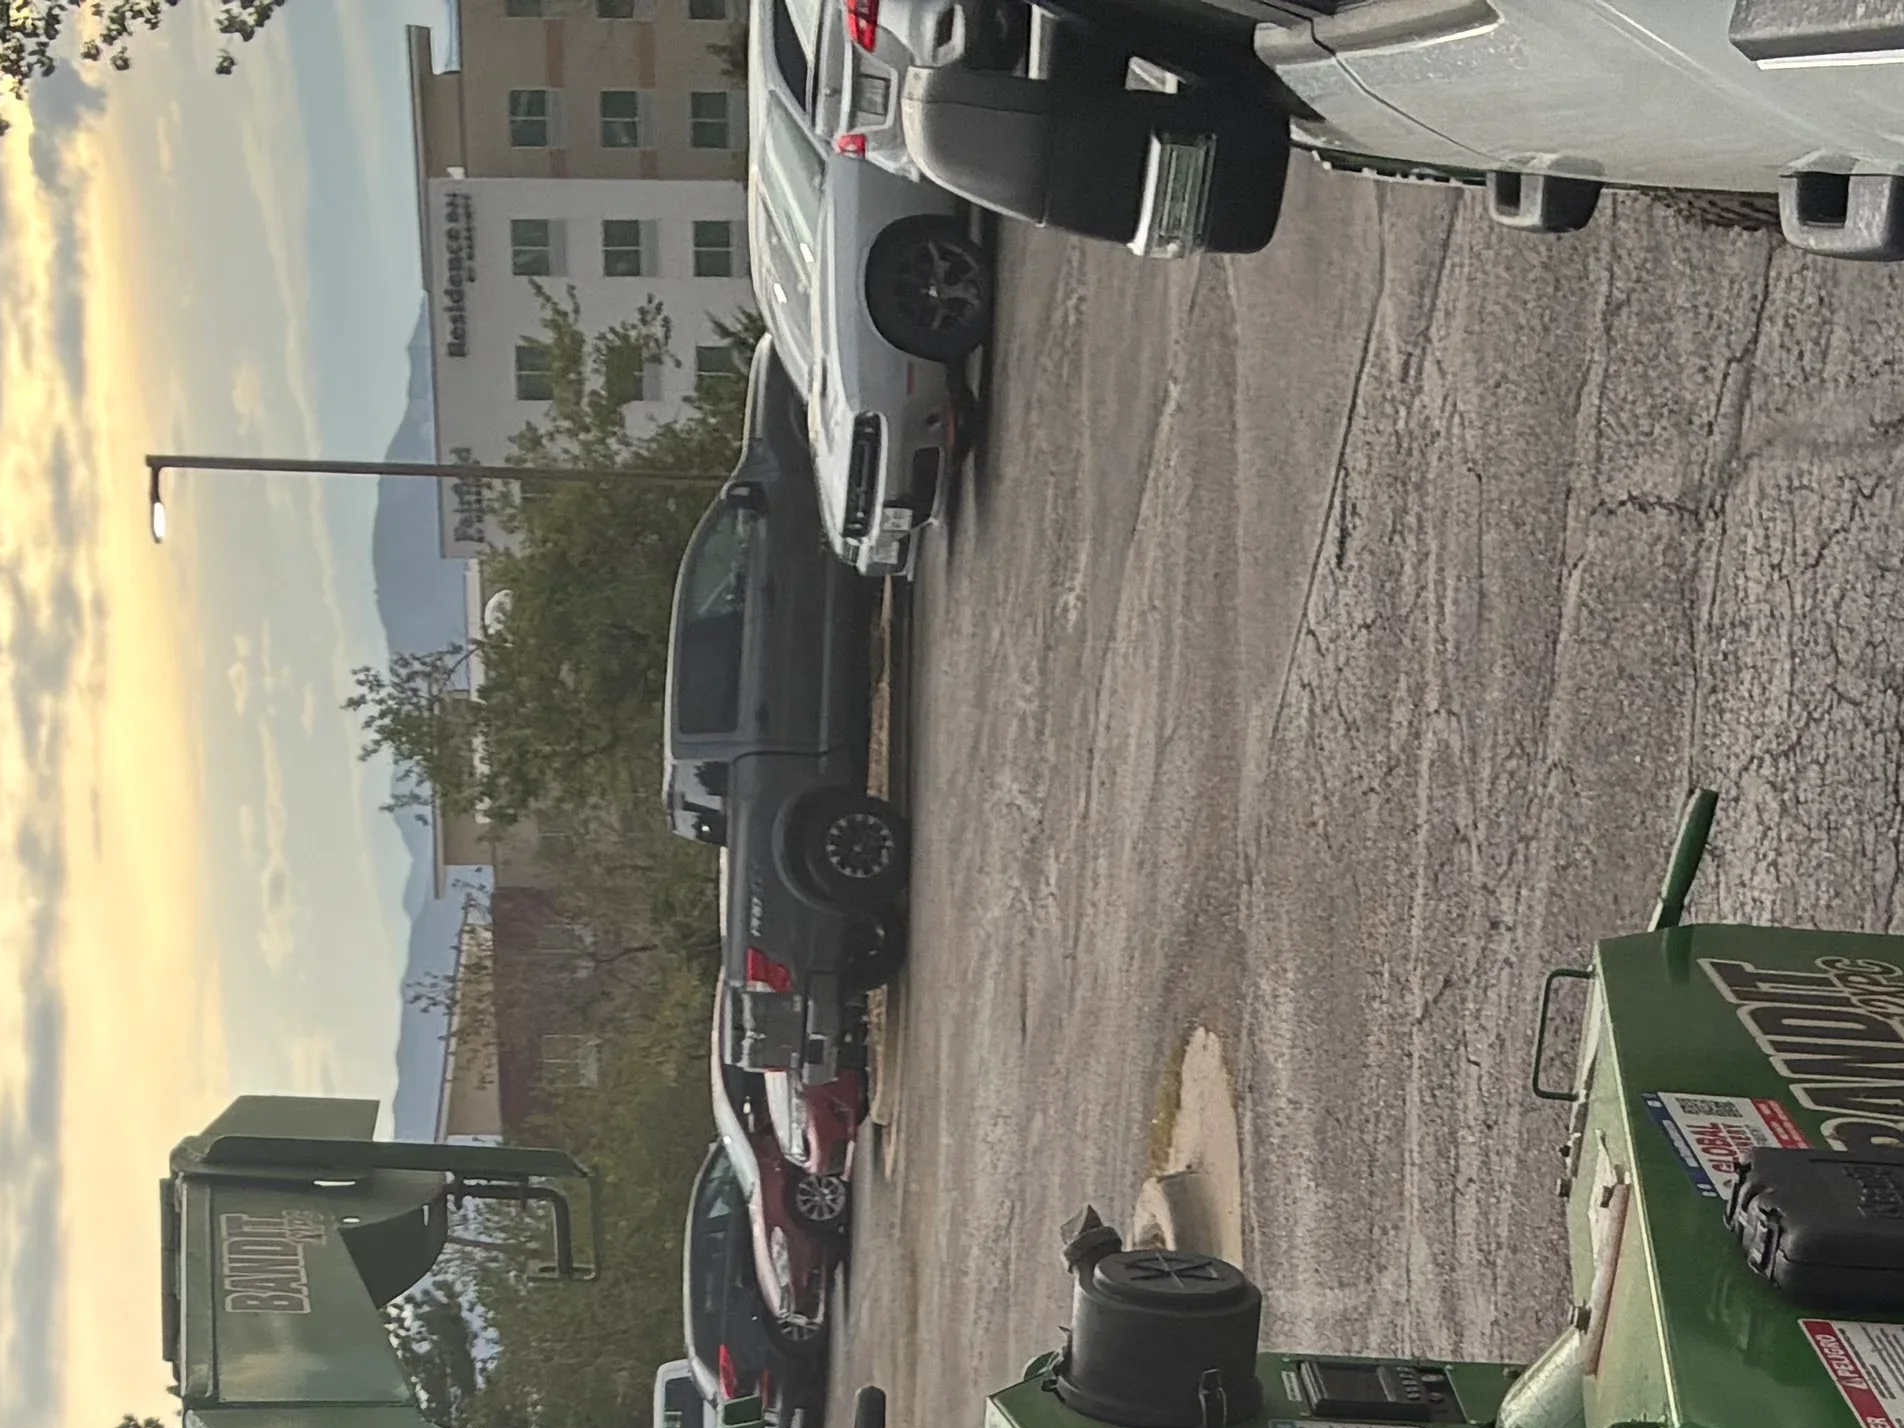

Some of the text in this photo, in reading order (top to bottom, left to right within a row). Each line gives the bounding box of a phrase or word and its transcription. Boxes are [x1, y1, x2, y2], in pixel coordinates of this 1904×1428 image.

[443, 228, 466, 357] Residence
[1685, 1122, 1739, 1174] GLOBAL
[220, 1214, 311, 1313] BANDIT
[1815, 1334, 1858, 1377] PELIGRO
